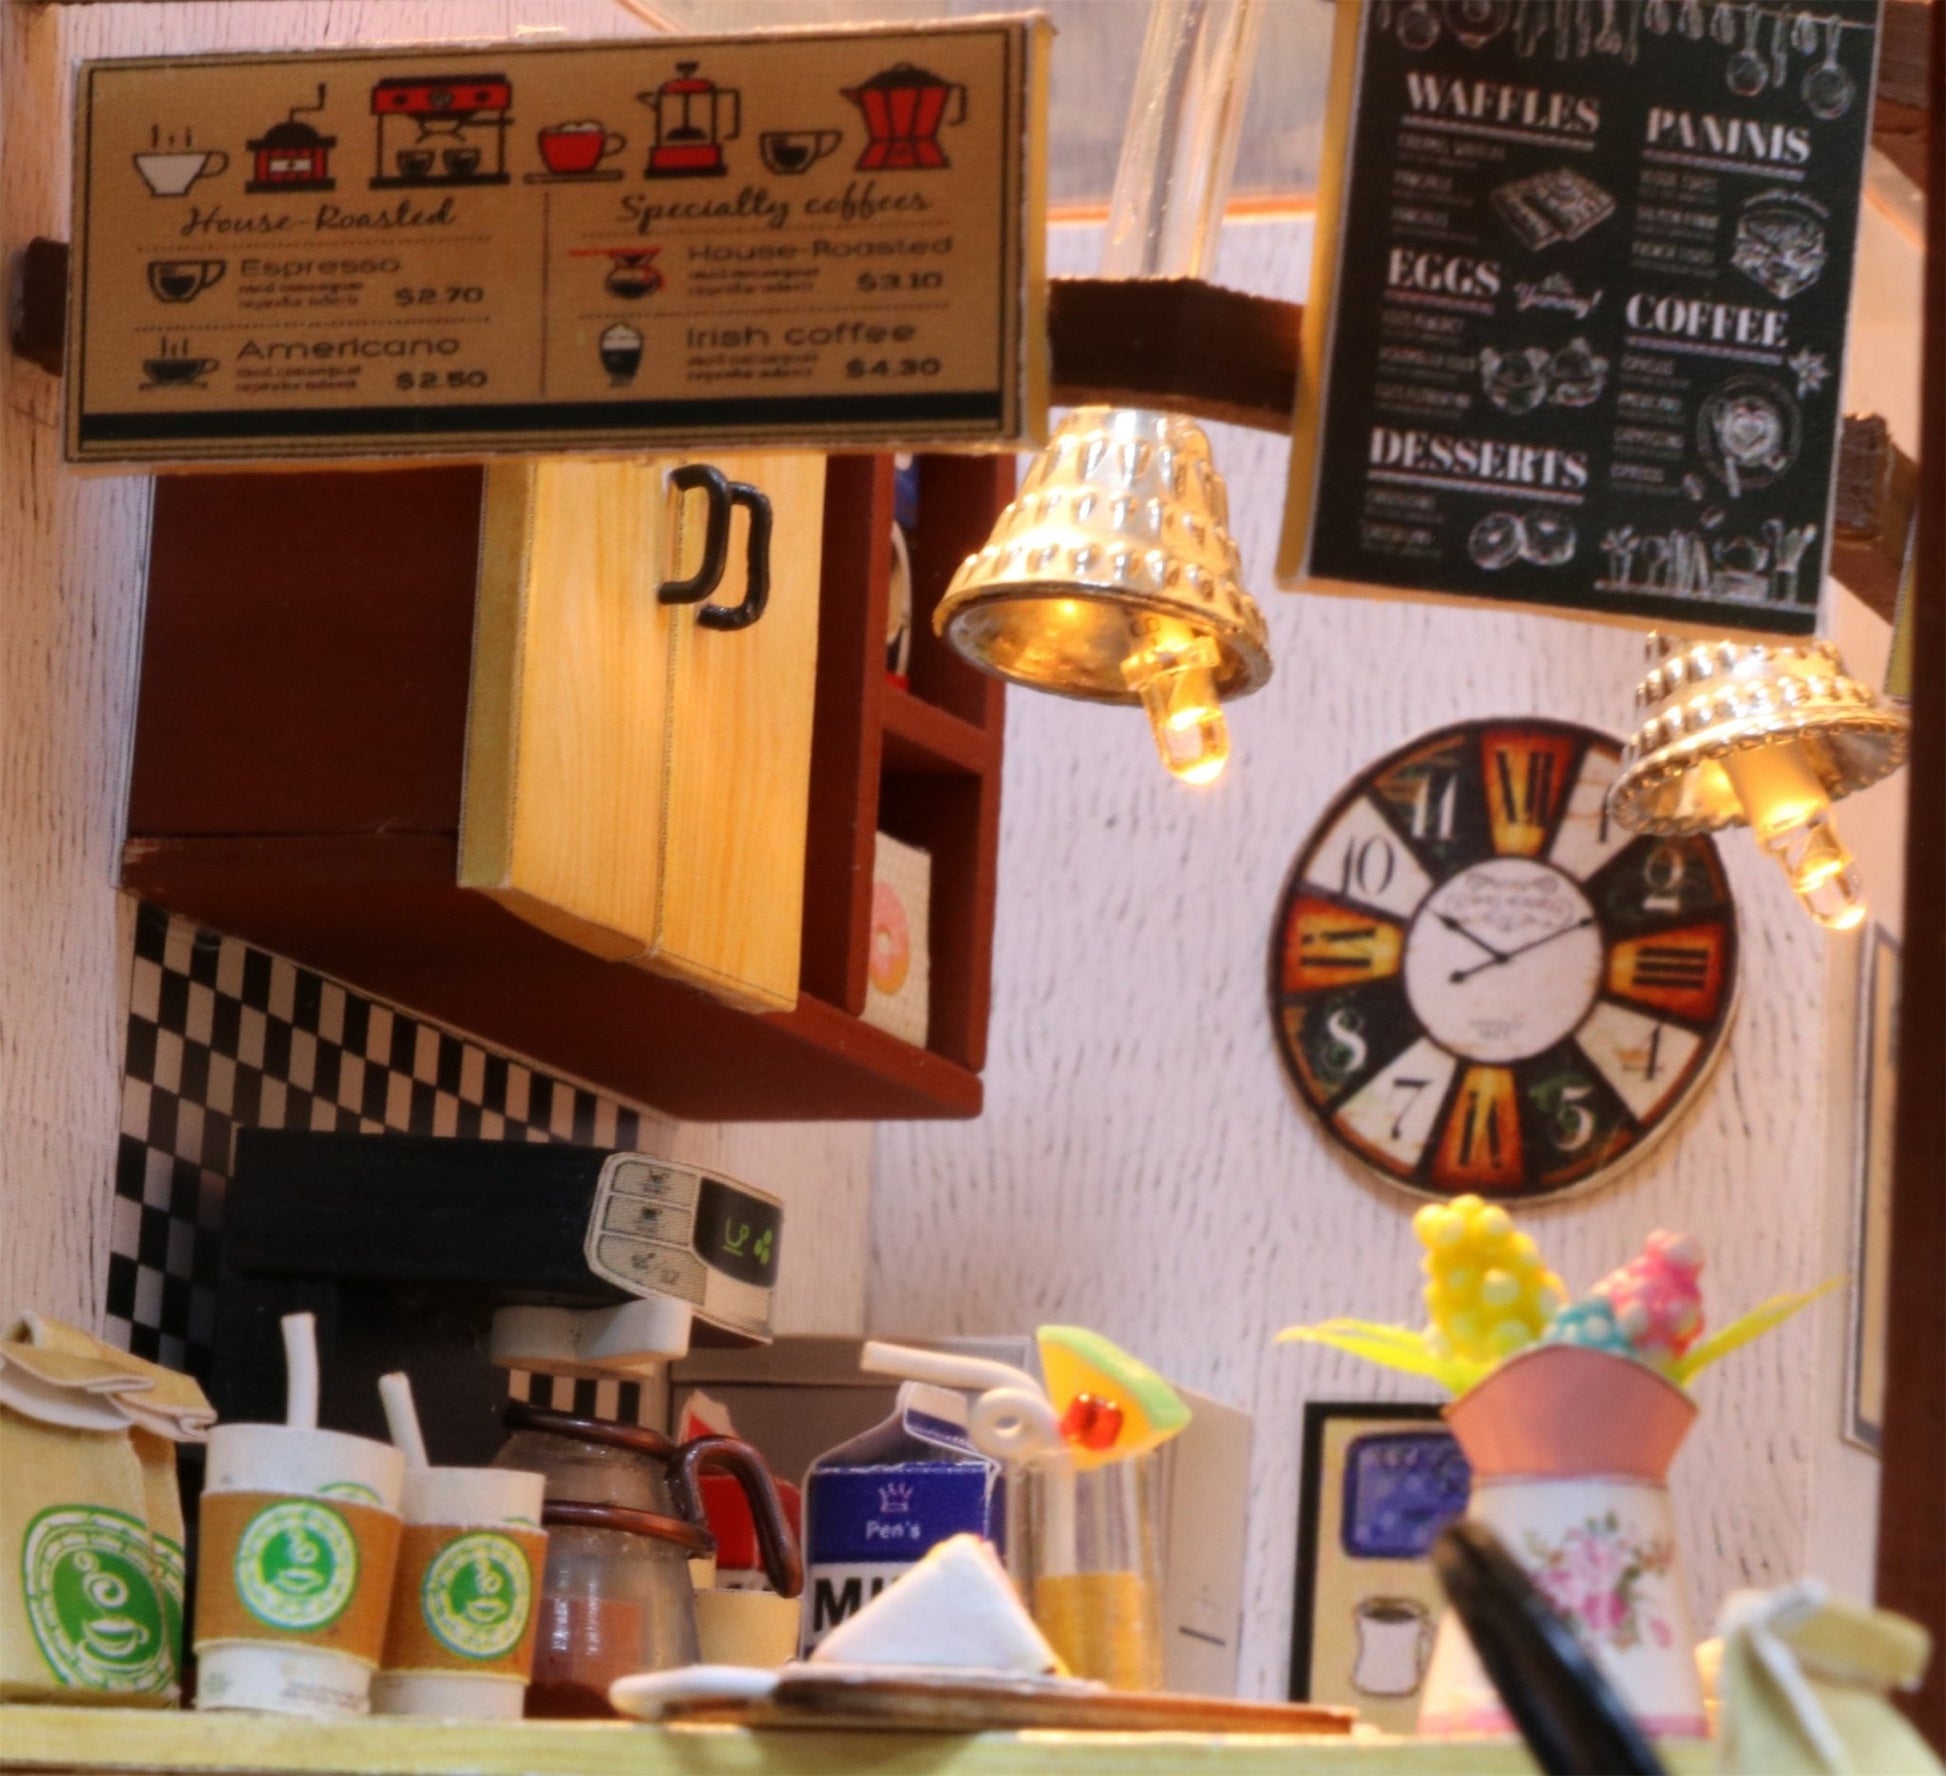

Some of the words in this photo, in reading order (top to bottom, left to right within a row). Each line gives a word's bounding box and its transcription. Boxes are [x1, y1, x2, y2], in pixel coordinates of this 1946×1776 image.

[1406, 71, 1600, 134] WAFFLES
[1646, 107, 1811, 164] PANINIS
[615, 185, 790, 235] Specialty
[803, 180, 932, 222] coffees
[240, 257, 402, 279] Espresso
[856, 271, 944, 293] $3.10
[1387, 248, 1501, 296] EGGS
[395, 286, 485, 308] $2.70
[1625, 292, 1790, 348] COFFEE
[236, 335, 461, 361] Americano
[686, 325, 770, 348] Irish
[784, 322, 917, 347] coffee
[395, 369, 490, 391] $2.50
[845, 356, 942, 380] $4.30
[1368, 425, 1589, 489] DESSERTS
[1410, 771, 1458, 840] 11
[1341, 835, 1395, 898] 10
[1320, 1007, 1369, 1073] 8
[1390, 1073, 1434, 1141] 7
[1549, 1085, 1596, 1152] 5
[864, 1519, 922, 1541] Pen's
